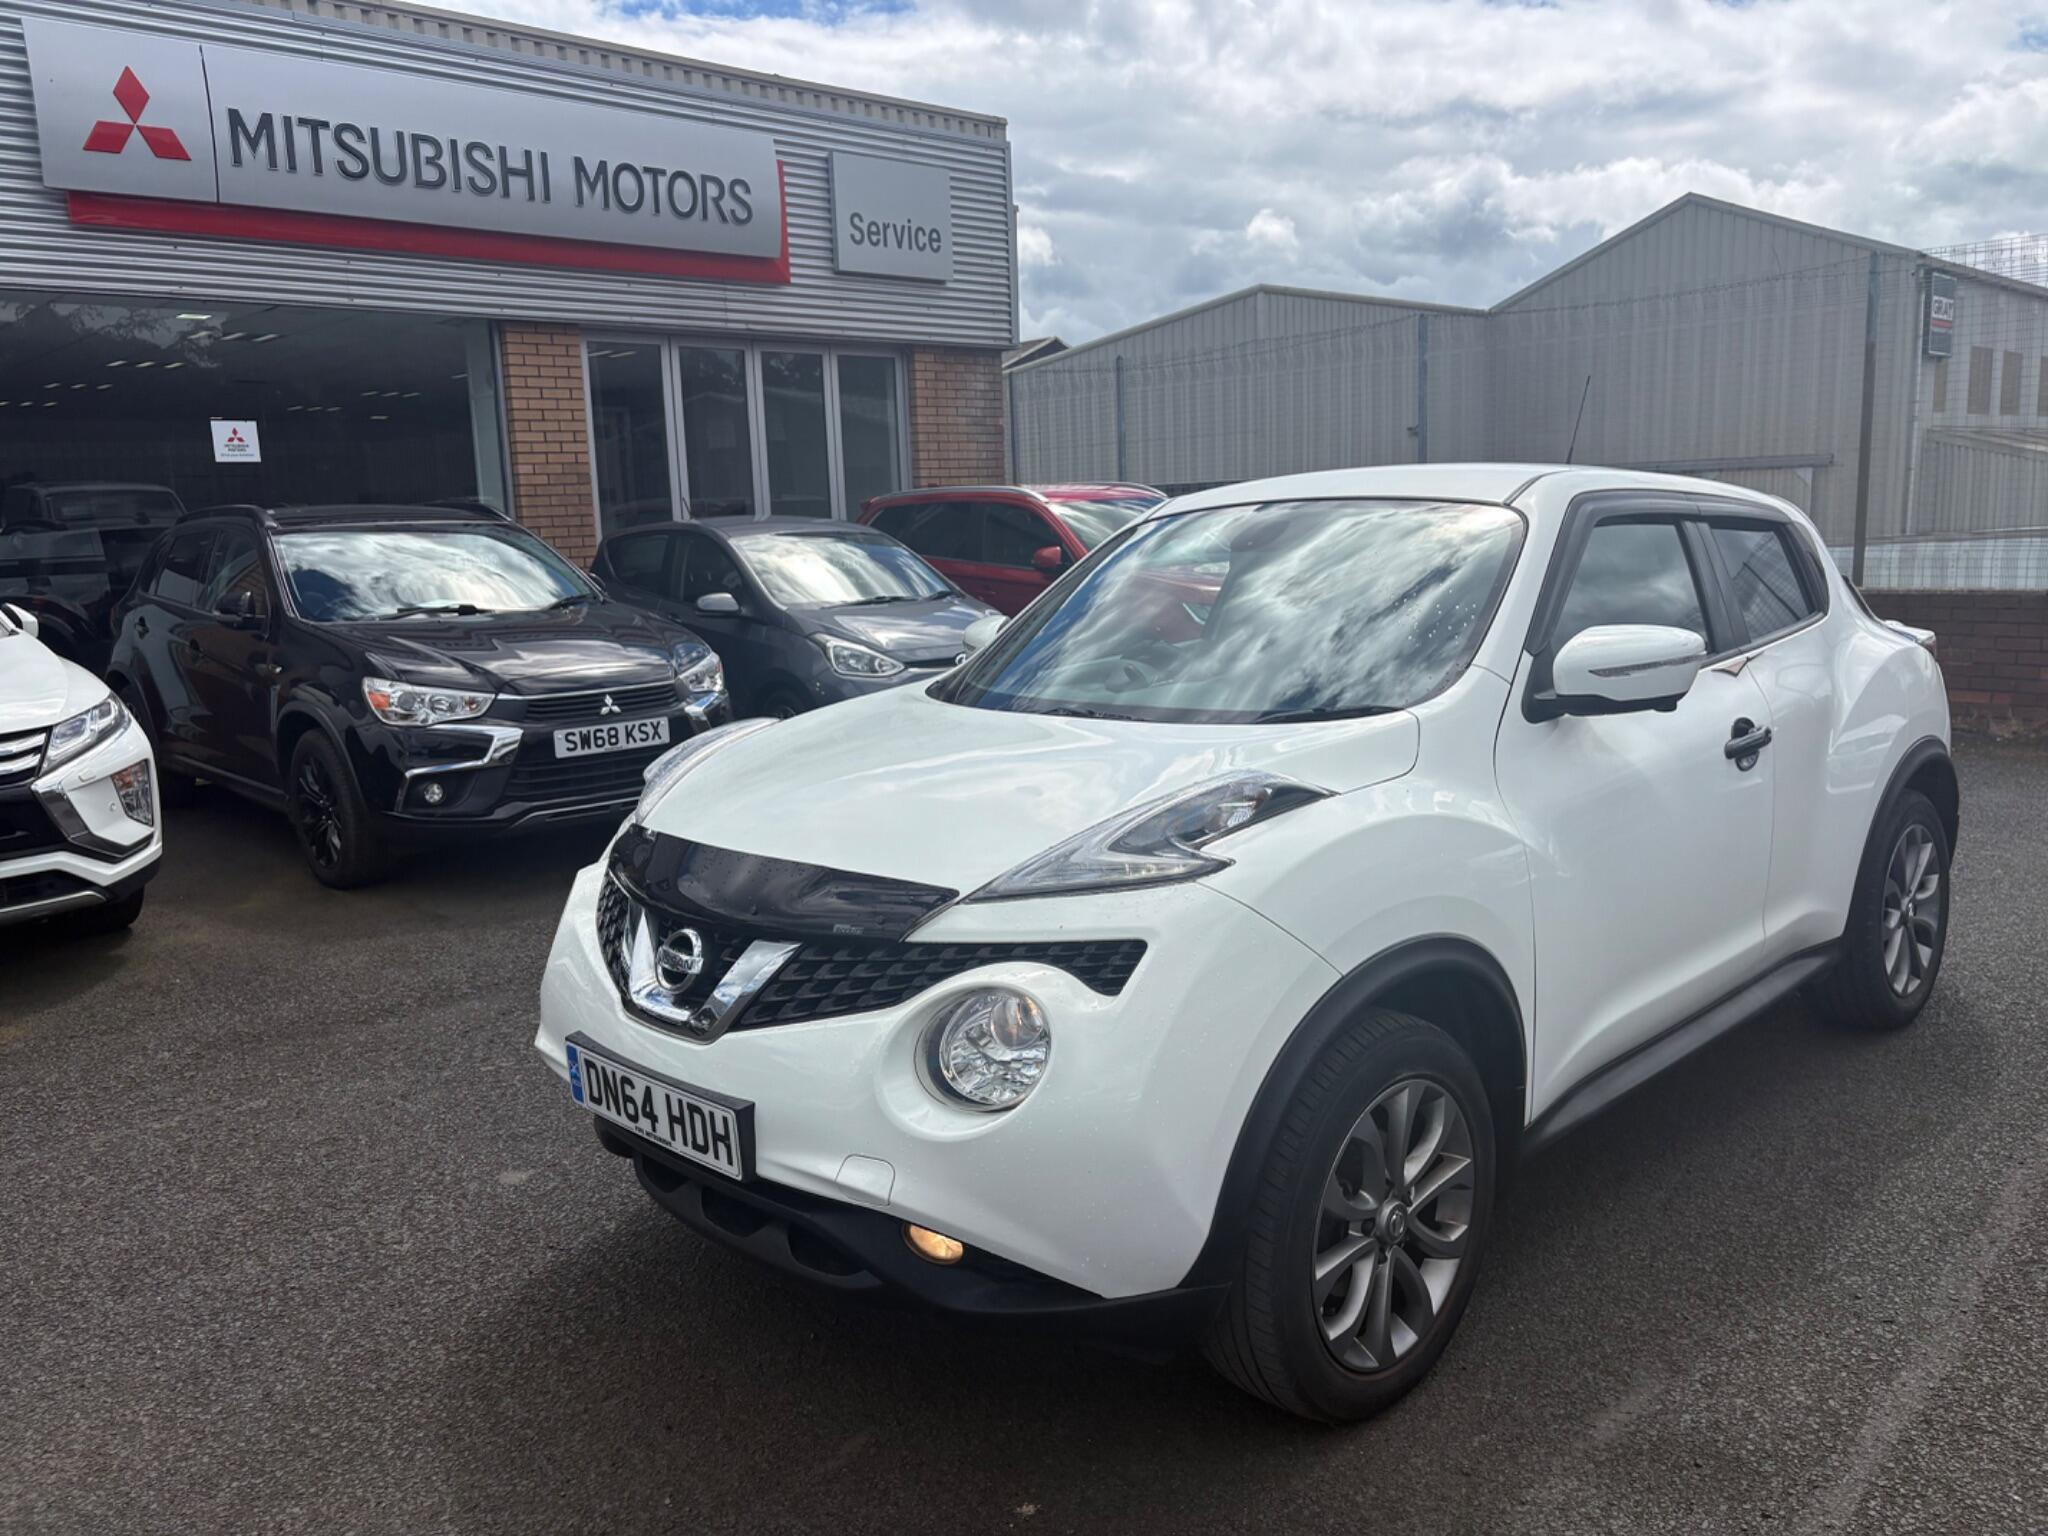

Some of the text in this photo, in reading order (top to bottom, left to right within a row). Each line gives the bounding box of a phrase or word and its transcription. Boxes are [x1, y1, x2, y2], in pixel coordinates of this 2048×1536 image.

[227, 107, 753, 225] MITSUBISHI MOTORS
[850, 212, 942, 253] Service
[564, 721, 662, 752] SW68 KSX
[584, 1058, 734, 1166] DN64 HDH
